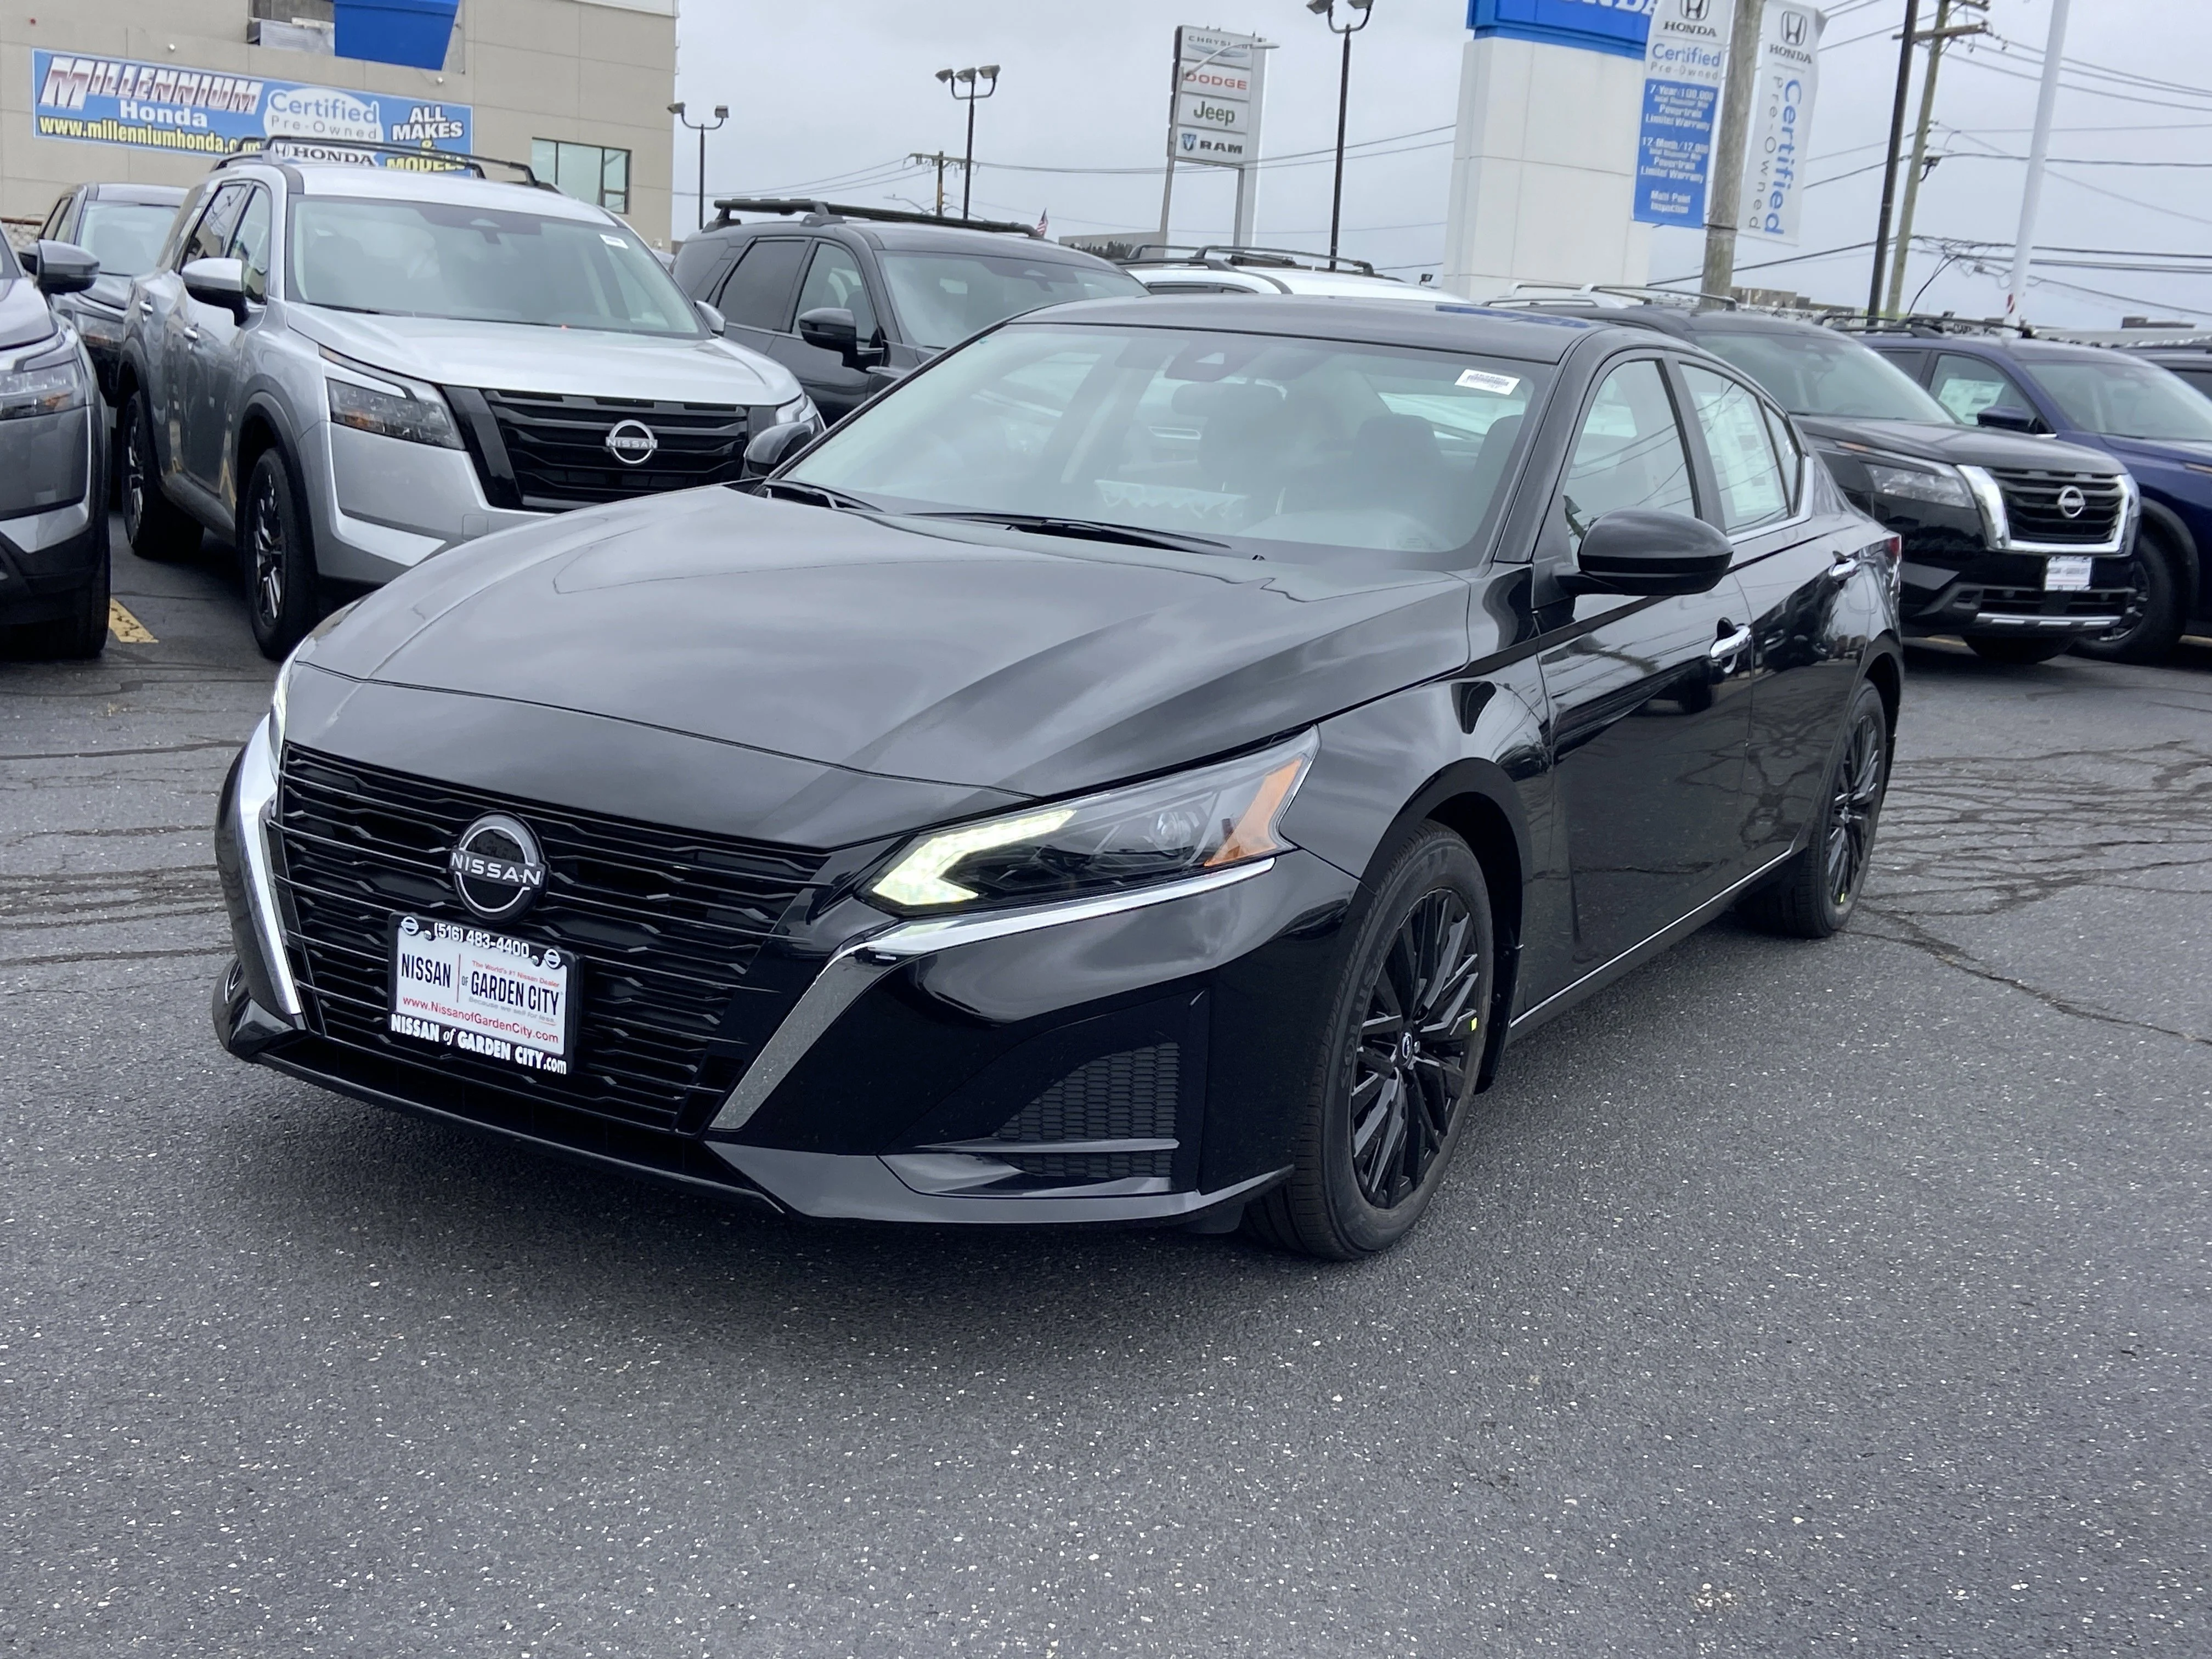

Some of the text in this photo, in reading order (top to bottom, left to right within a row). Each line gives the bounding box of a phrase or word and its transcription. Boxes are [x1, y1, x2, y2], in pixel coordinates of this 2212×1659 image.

[1663, 21, 1717, 37] HONDA
[1652, 43, 1722, 67] Certified
[1769, 44, 1813, 64] HONDA
[1651, 61, 1718, 80] Pre-Owned
[38, 55, 263, 115] MILLENNIUM
[120, 100, 208, 128] Honda
[270, 92, 377, 123] Certified
[409, 106, 447, 123] ALL
[1194, 101, 1235, 126] Jeep
[271, 115, 377, 139] Pre-Owned
[392, 122, 464, 140] MAKES
[294, 147, 375, 165] HONDA
[1200, 140, 1243, 154] RAM
[1749, 76, 1784, 230] Pre-Owned
[1764, 79, 1802, 235] Certified
[607, 439, 657, 449] NISSAN
[451, 852, 541, 885] NISSAN
[434, 923, 529, 958] (516) 483-4400
[472, 960, 483, 968] The
[517, 972, 538, 982] Nissan
[402, 953, 559, 1015] NISSAN OF GARDEN CITY
[403, 996, 558, 1043] www.NissanofGardenCity.com
[391, 1014, 439, 1042] NISSAN
[443, 1028, 456, 1046] of
[457, 1031, 511, 1061] GARDEN
